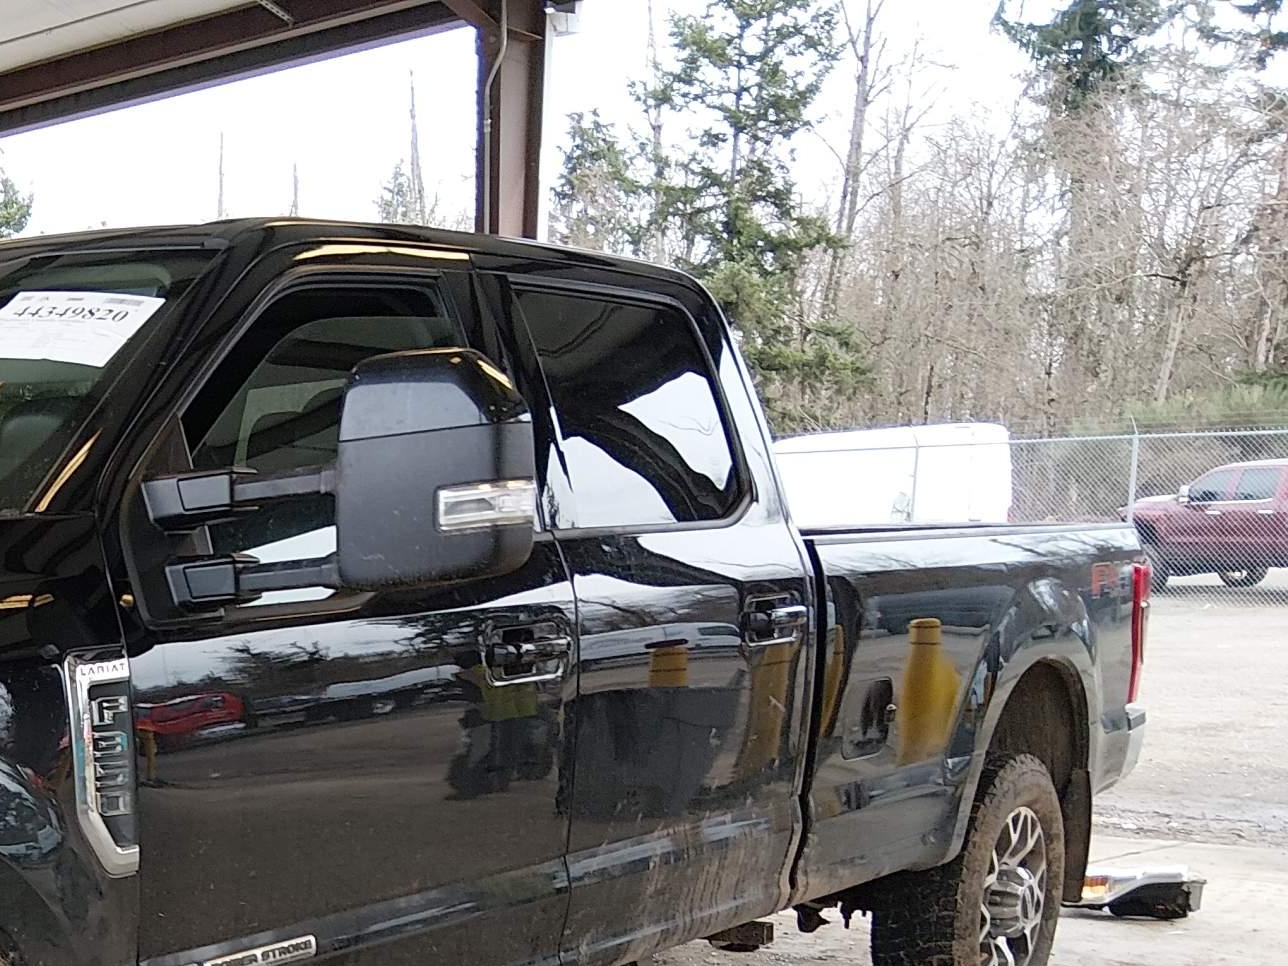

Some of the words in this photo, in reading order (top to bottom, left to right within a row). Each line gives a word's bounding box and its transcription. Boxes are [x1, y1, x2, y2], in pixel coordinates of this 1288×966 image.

[13, 305, 129, 322] 44349820
[80, 662, 125, 676] LARIAT
[261, 939, 312, 961] STROKE
